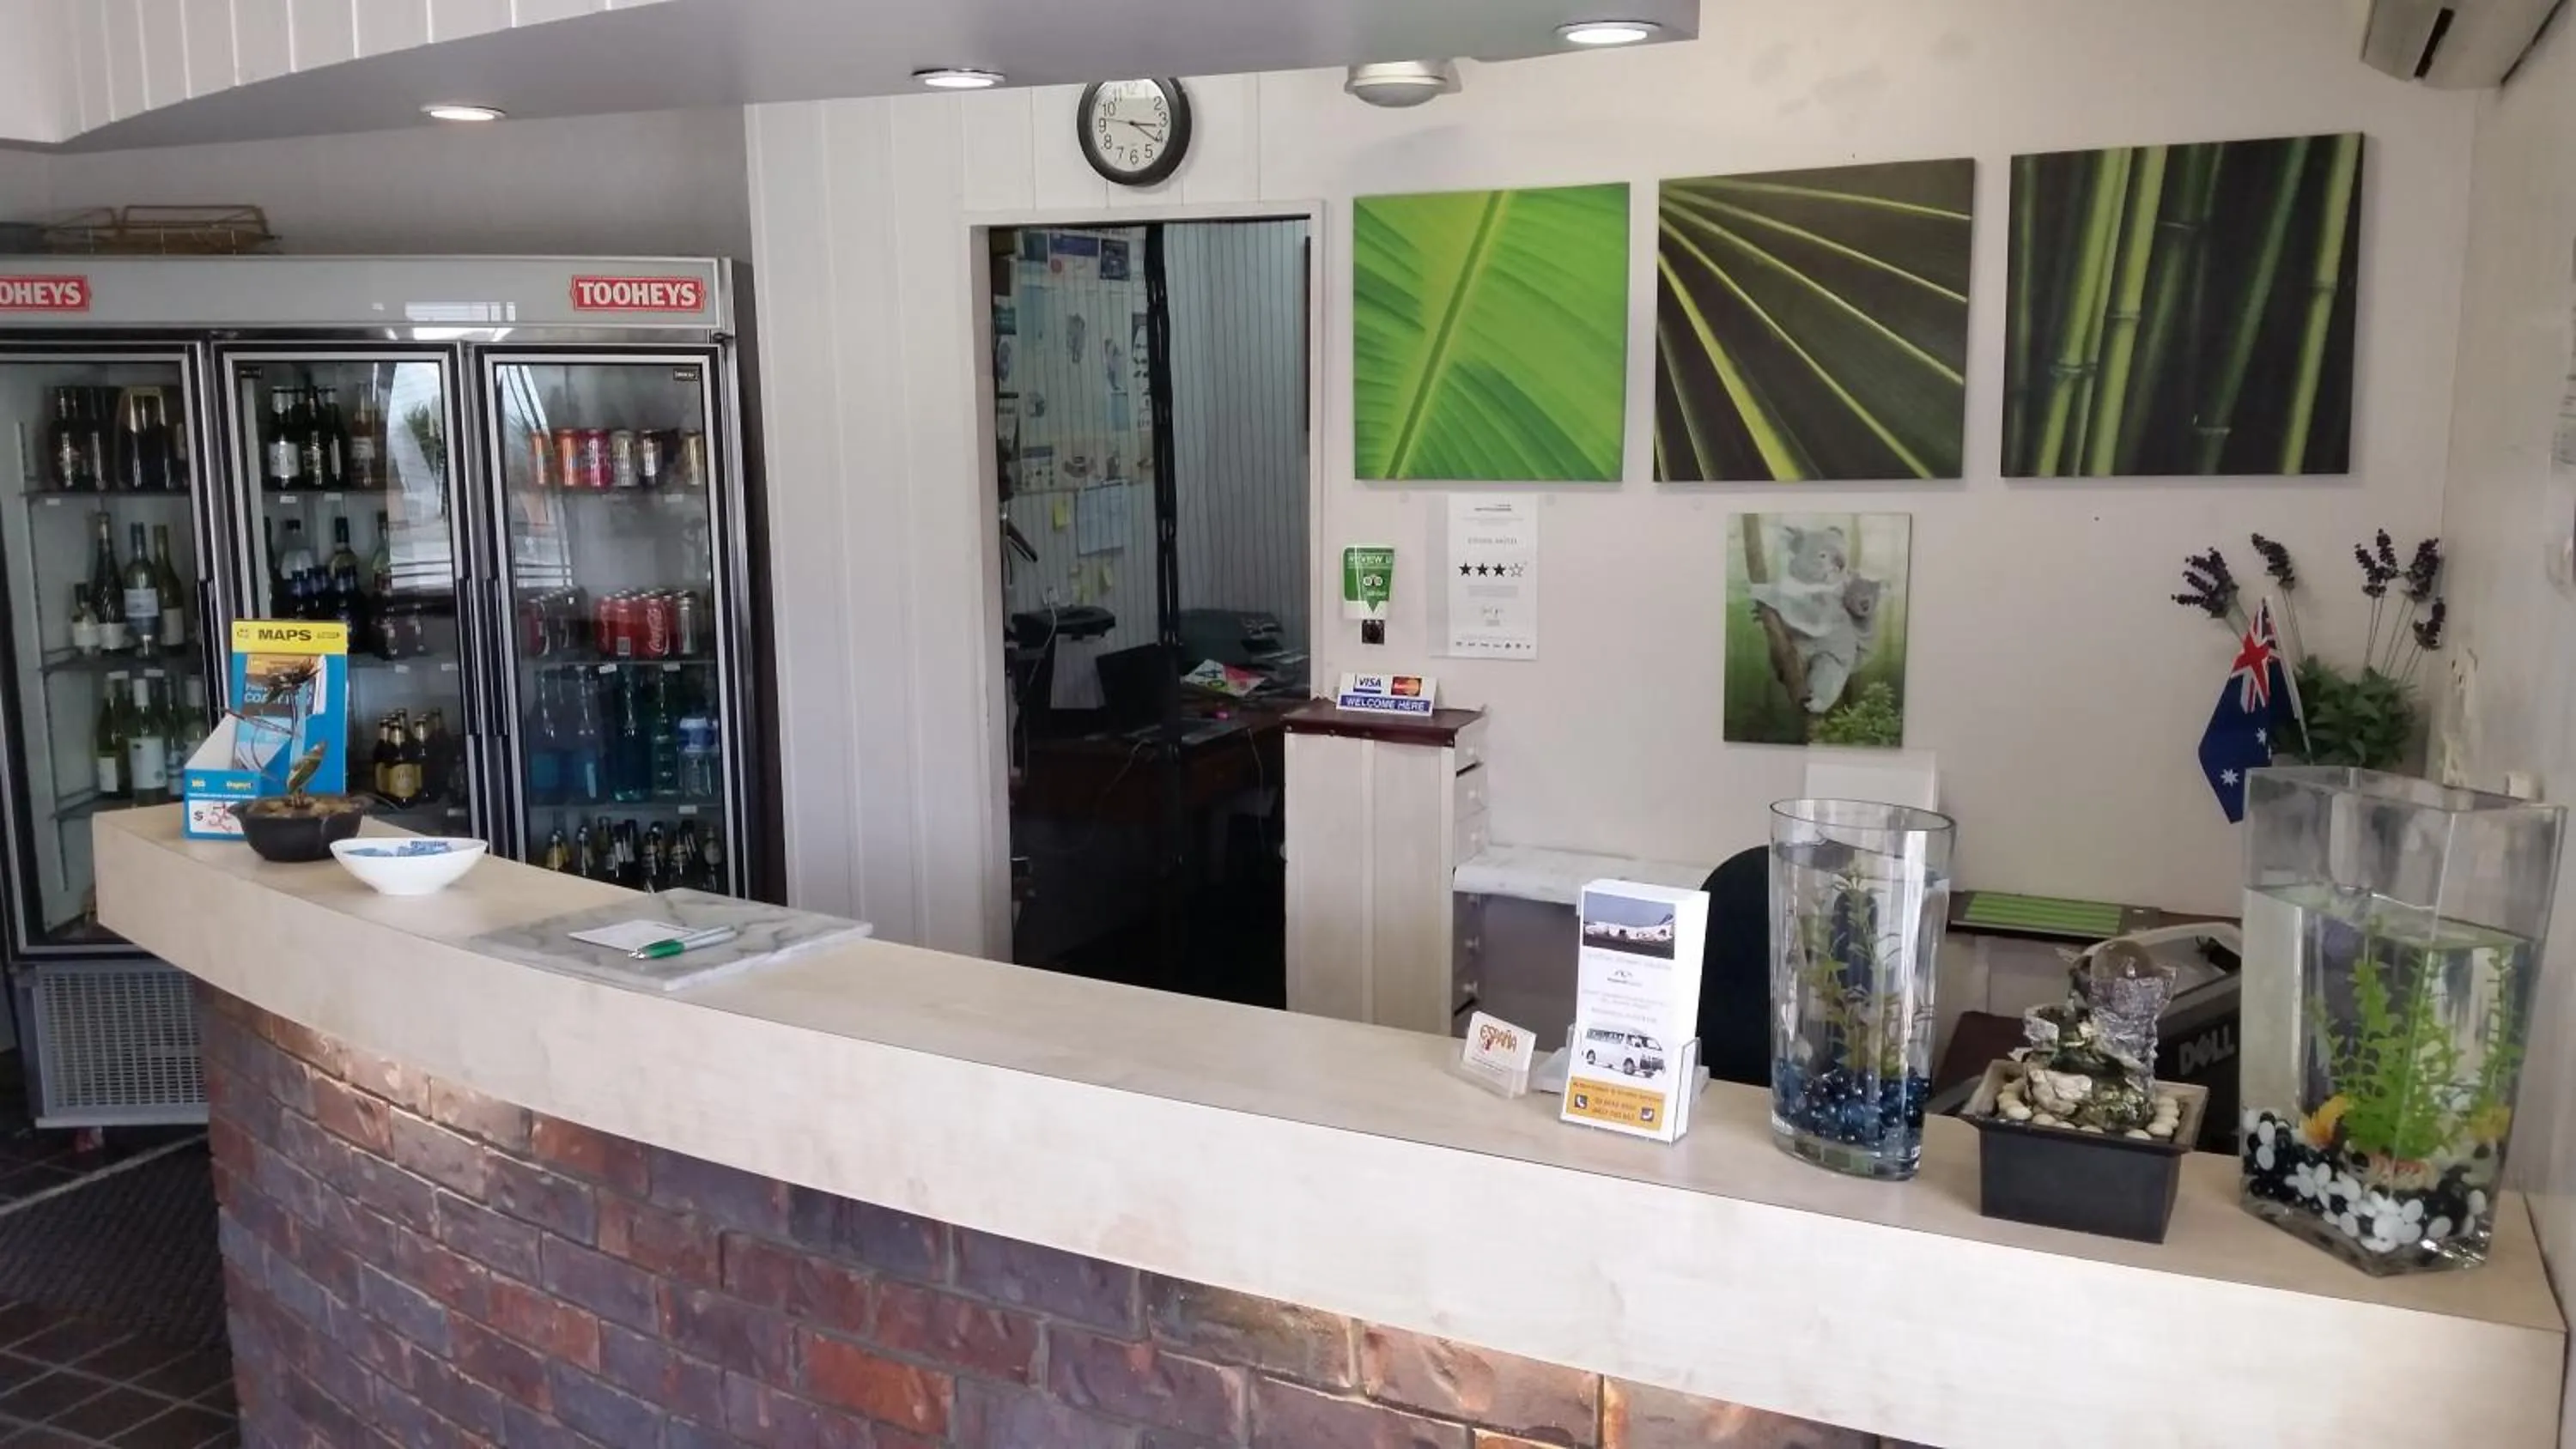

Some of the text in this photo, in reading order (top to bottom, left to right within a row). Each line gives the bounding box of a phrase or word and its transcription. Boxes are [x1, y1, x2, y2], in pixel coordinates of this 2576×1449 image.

[1102, 101, 1115, 117] 10
[1154, 96, 1163, 110] 2
[1099, 118, 1107, 134] 9
[1158, 112, 1168, 127] 3
[1103, 134, 1112, 149] 8
[1155, 130, 1163, 142] 4
[1116, 146, 1124, 159] 7
[1130, 149, 1139, 165] 6
[1145, 144, 1153, 159] 5
[578, 282, 696, 306] TOOHEYS
[258, 628, 312, 641] MAPS
[1358, 676, 1382, 688] VISA
[1346, 696, 1425, 712] WELCOME HERE
[2178, 1025, 2236, 1076] DELL
